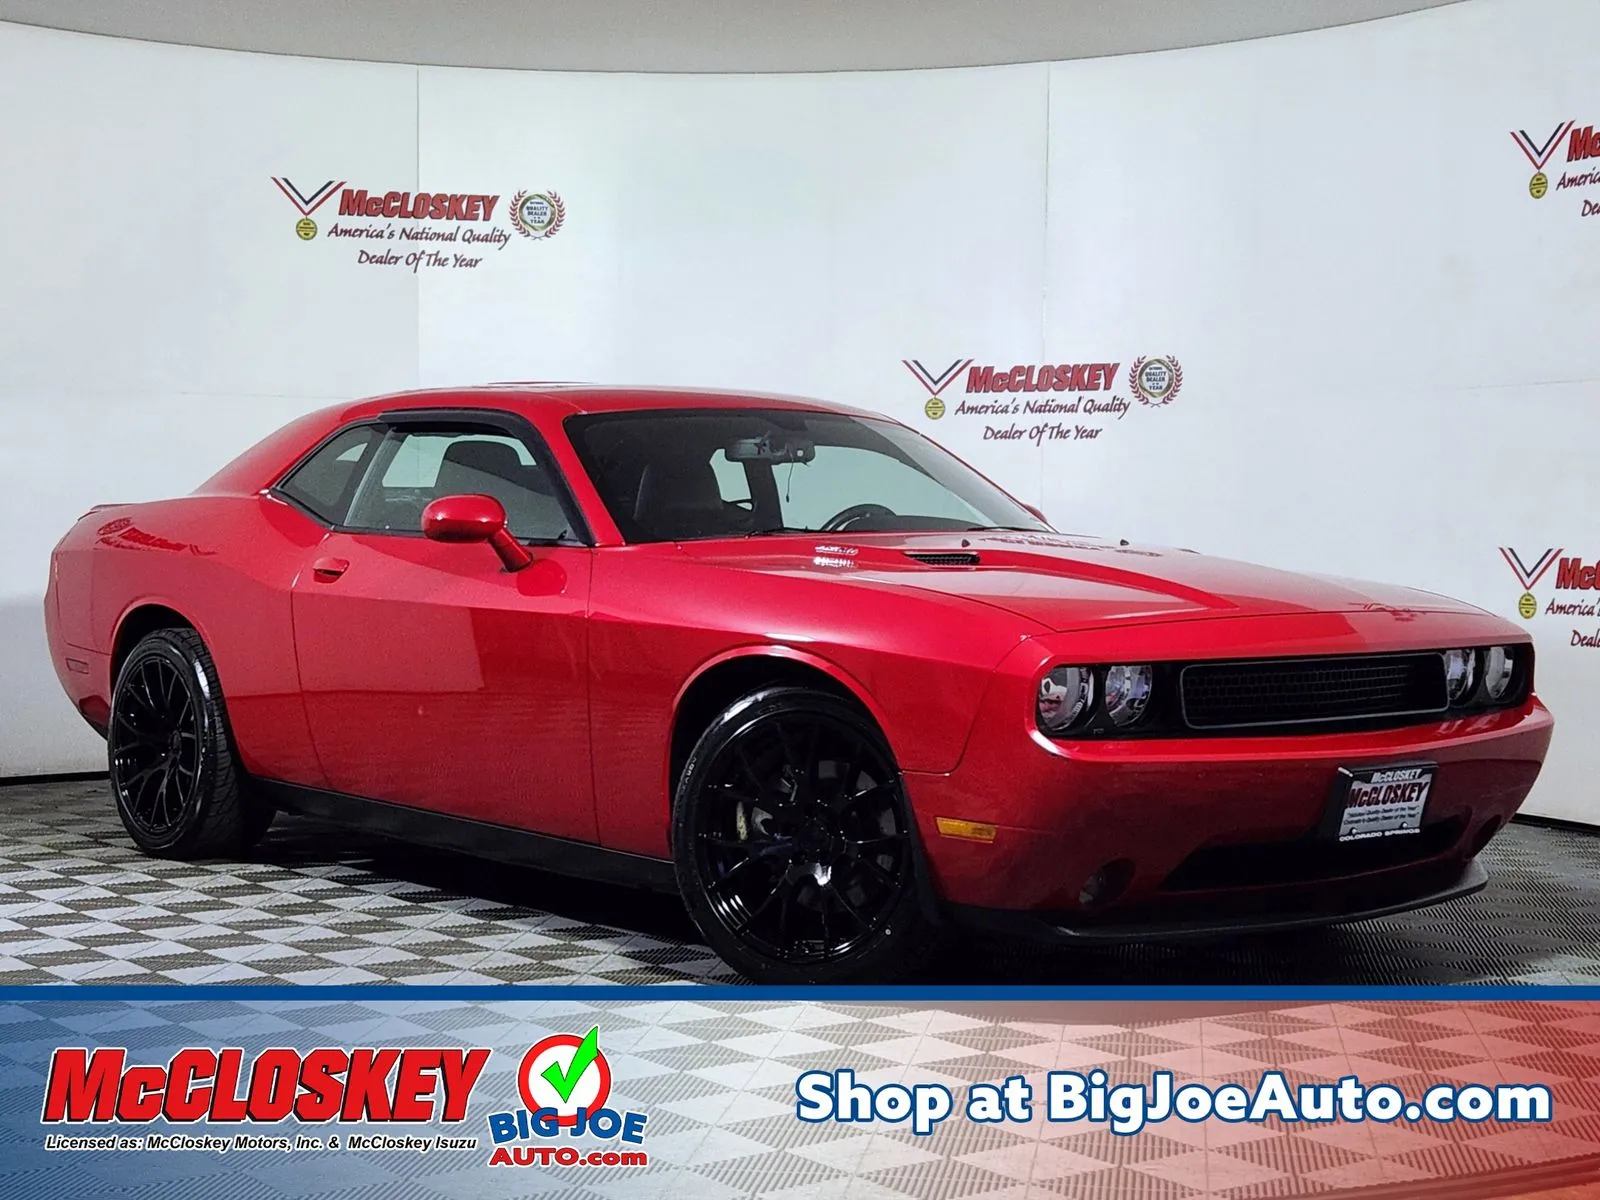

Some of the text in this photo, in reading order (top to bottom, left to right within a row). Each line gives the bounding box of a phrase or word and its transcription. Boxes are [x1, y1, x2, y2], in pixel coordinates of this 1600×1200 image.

[1556, 166, 1600, 190] Americ
[338, 188, 500, 221] McCLOSKEY
[1581, 199, 1600, 217] De
[327, 222, 512, 251] America's National Quality
[357, 248, 483, 273] Dealer Of The Year
[965, 362, 1120, 394] McCLOSKEY
[954, 395, 1131, 420] America's National Quality
[983, 422, 1103, 447] Dealer Of The Year
[1349, 782, 1430, 808] McCLOSKEY
